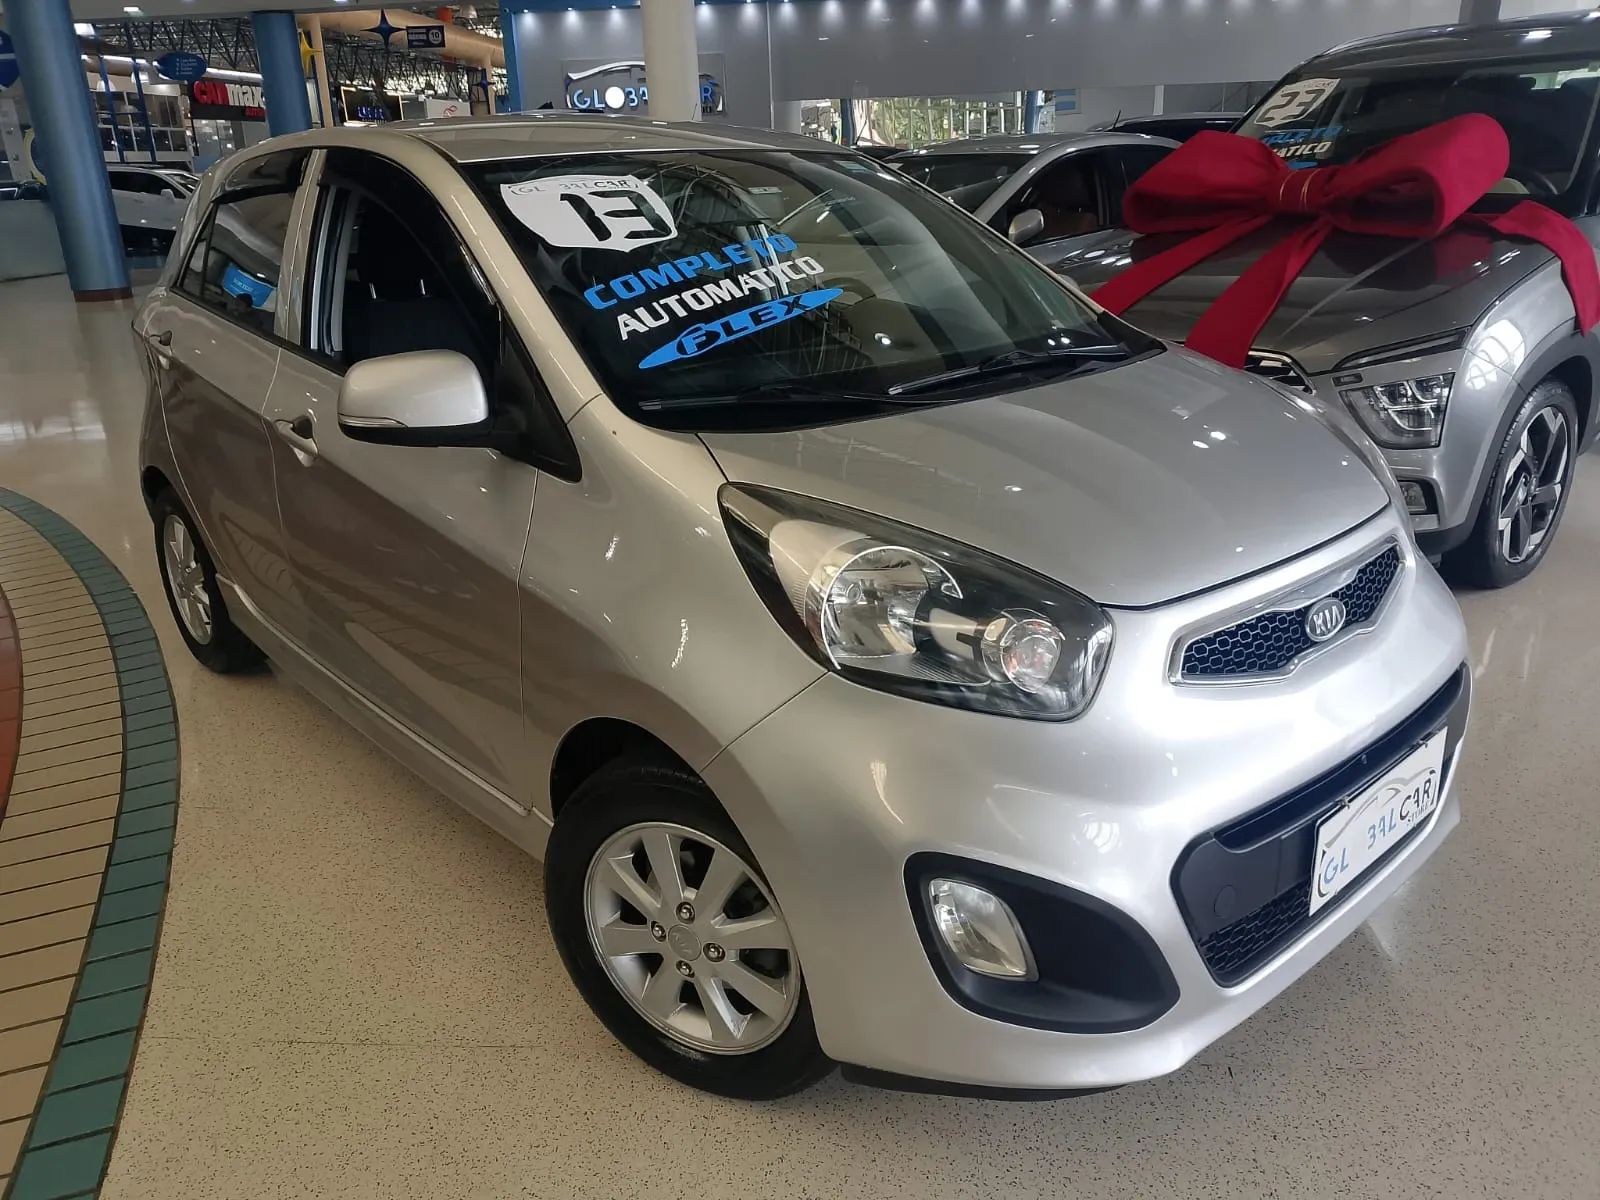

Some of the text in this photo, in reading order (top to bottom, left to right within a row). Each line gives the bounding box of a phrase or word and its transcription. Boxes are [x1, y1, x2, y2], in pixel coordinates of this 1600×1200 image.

[1260, 88, 1326, 122] 23
[560, 189, 672, 242] 13
[584, 233, 798, 310] COMPLETO
[684, 294, 813, 356] FLEX
[1313, 605, 1341, 635] KIA
